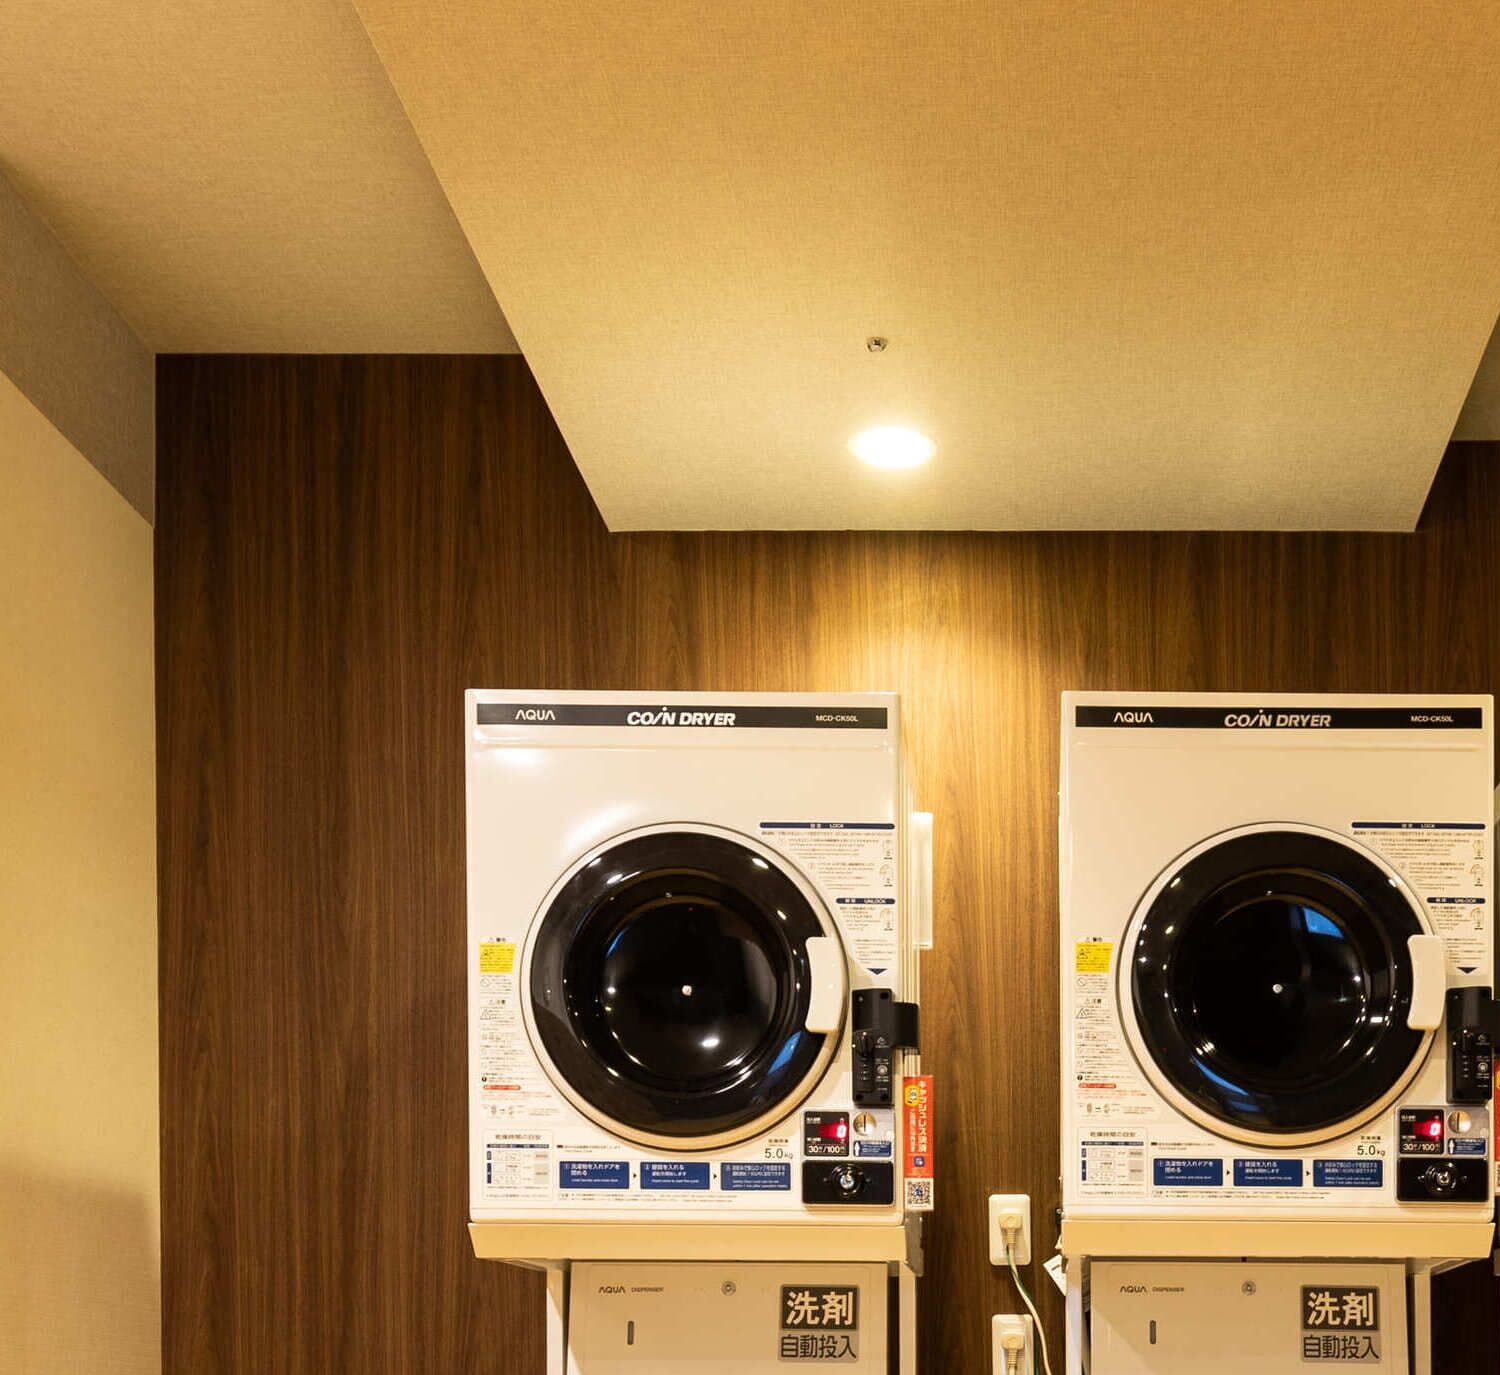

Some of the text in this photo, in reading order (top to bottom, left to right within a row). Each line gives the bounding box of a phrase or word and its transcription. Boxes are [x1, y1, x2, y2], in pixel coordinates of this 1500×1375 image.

[515, 709, 556, 721] AQUA
[627, 706, 736, 727] COIN DRYER
[1113, 711, 1153, 723] AQUA
[1224, 709, 1332, 727] COIN DRYER
[918, 1080, 928, 1153] キャッシュレス決済
[598, 1285, 626, 1294] AQUA
[1119, 1285, 1147, 1294] AQUA
[785, 1290, 854, 1326] 洗剤
[1307, 1291, 1374, 1326] 洗剤
[780, 1334, 857, 1359] 自動投入
[1303, 1335, 1380, 1360] 自動投入
